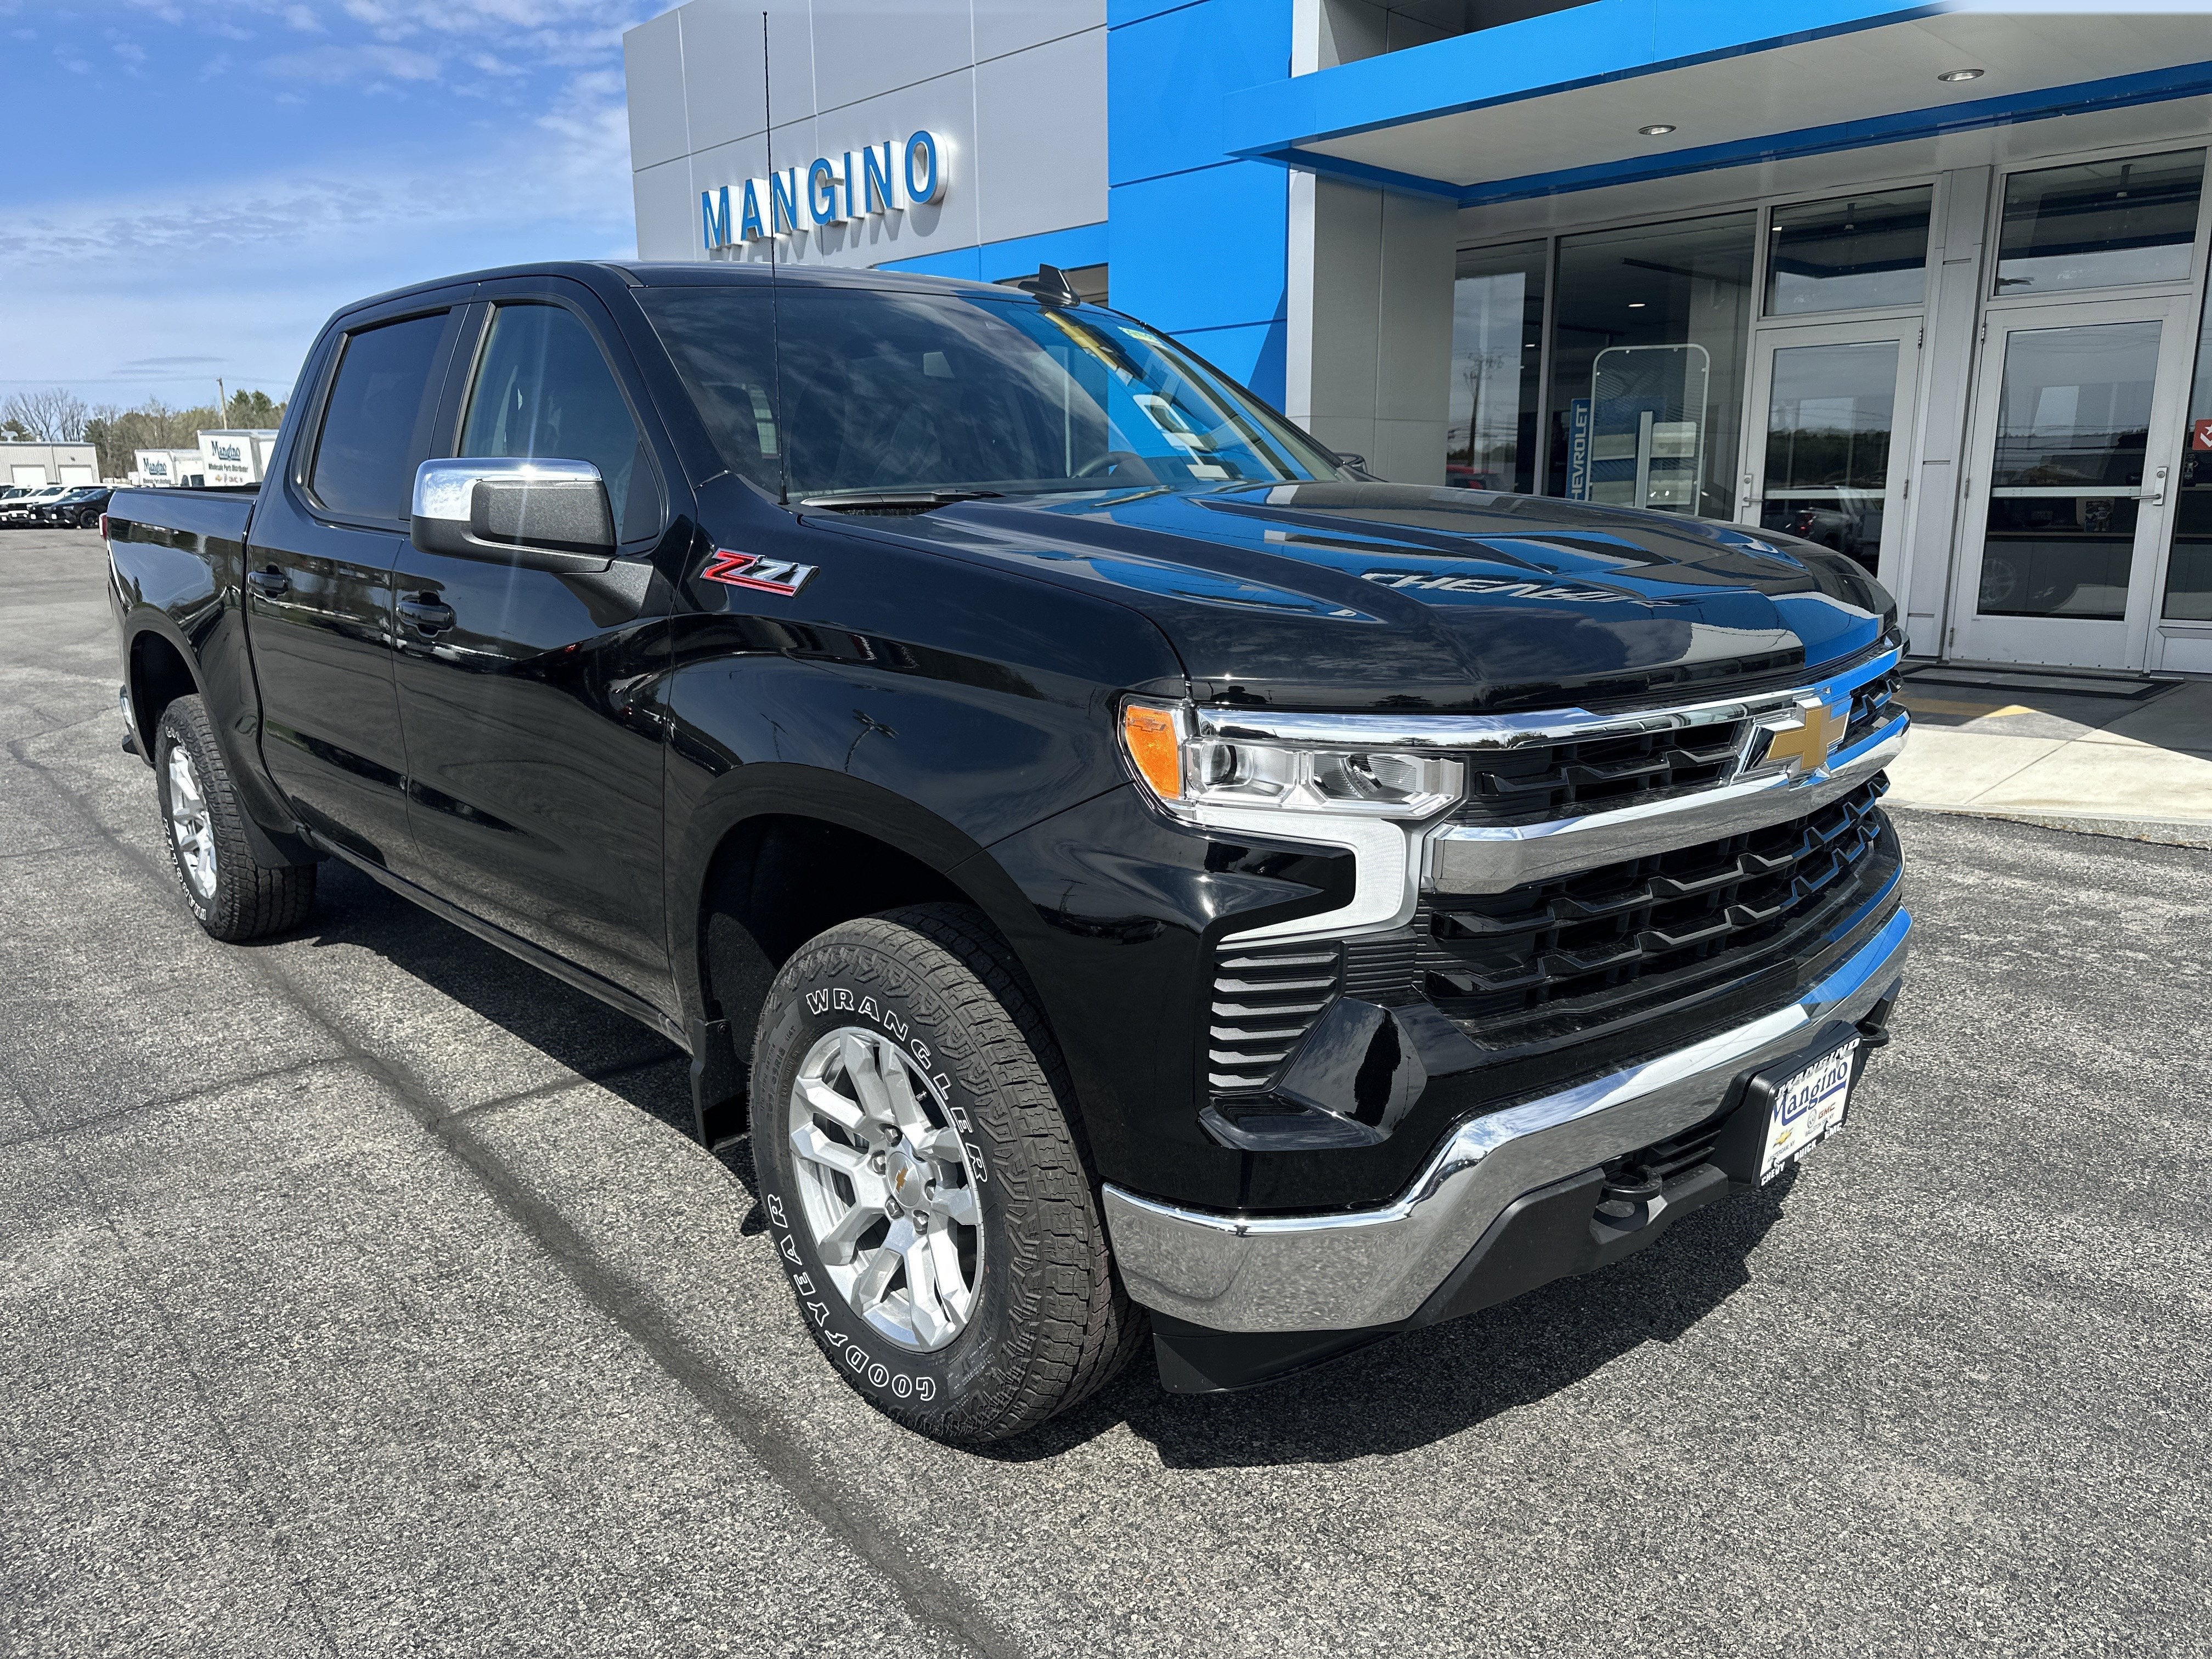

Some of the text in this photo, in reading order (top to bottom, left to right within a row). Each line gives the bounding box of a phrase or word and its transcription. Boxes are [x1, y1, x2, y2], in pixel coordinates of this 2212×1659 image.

[702, 129, 948, 250] MANGINO
[143, 458, 167, 476] Mangino
[211, 441, 241, 462] Mangino
[1571, 404, 1588, 500] HEVROLET
[699, 548, 820, 598] Z71
[806, 988, 988, 1182] WRANGLER
[1773, 1062, 1848, 1126] Mangino
[1775, 1037, 1860, 1101] MANGINO
[1818, 1102, 1836, 1120] GMC
[1761, 1122, 1842, 1186] CHEVY BUICK GMC
[768, 1194, 936, 1401] GOODYEAR
